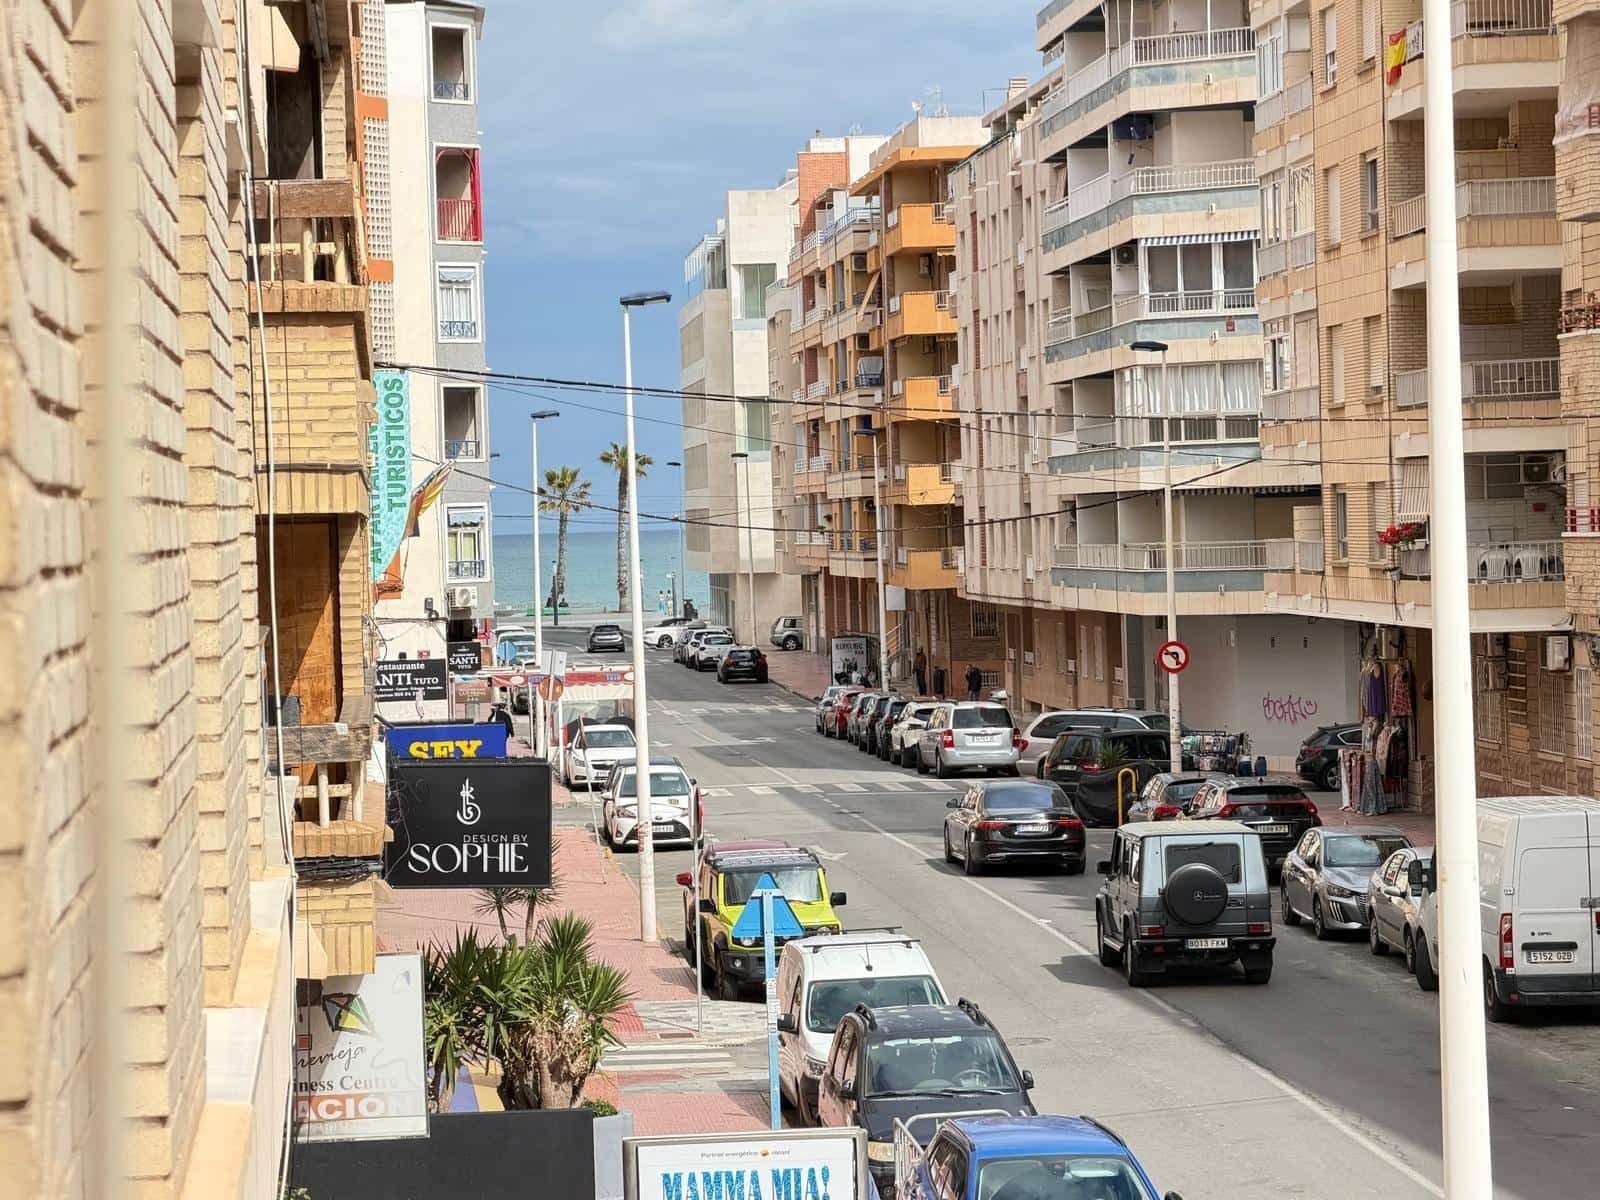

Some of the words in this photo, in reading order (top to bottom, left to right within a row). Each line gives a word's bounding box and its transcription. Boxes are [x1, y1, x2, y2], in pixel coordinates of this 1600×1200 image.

[383, 378, 407, 512] TURISTICOS
[449, 656, 478, 665] SANTI
[376, 673, 412, 686] ANTI
[413, 677, 439, 685] TUTO
[463, 834, 508, 843] DESIGN
[513, 834, 528, 842] BY
[408, 843, 529, 873] SOPHIE
[1532, 952, 1553, 961] 5152
[294, 1078, 334, 1092] iness
[340, 1075, 396, 1090] Cent
[660, 1170, 763, 1200] MAMMA
[771, 1165, 831, 1200] MIA!
